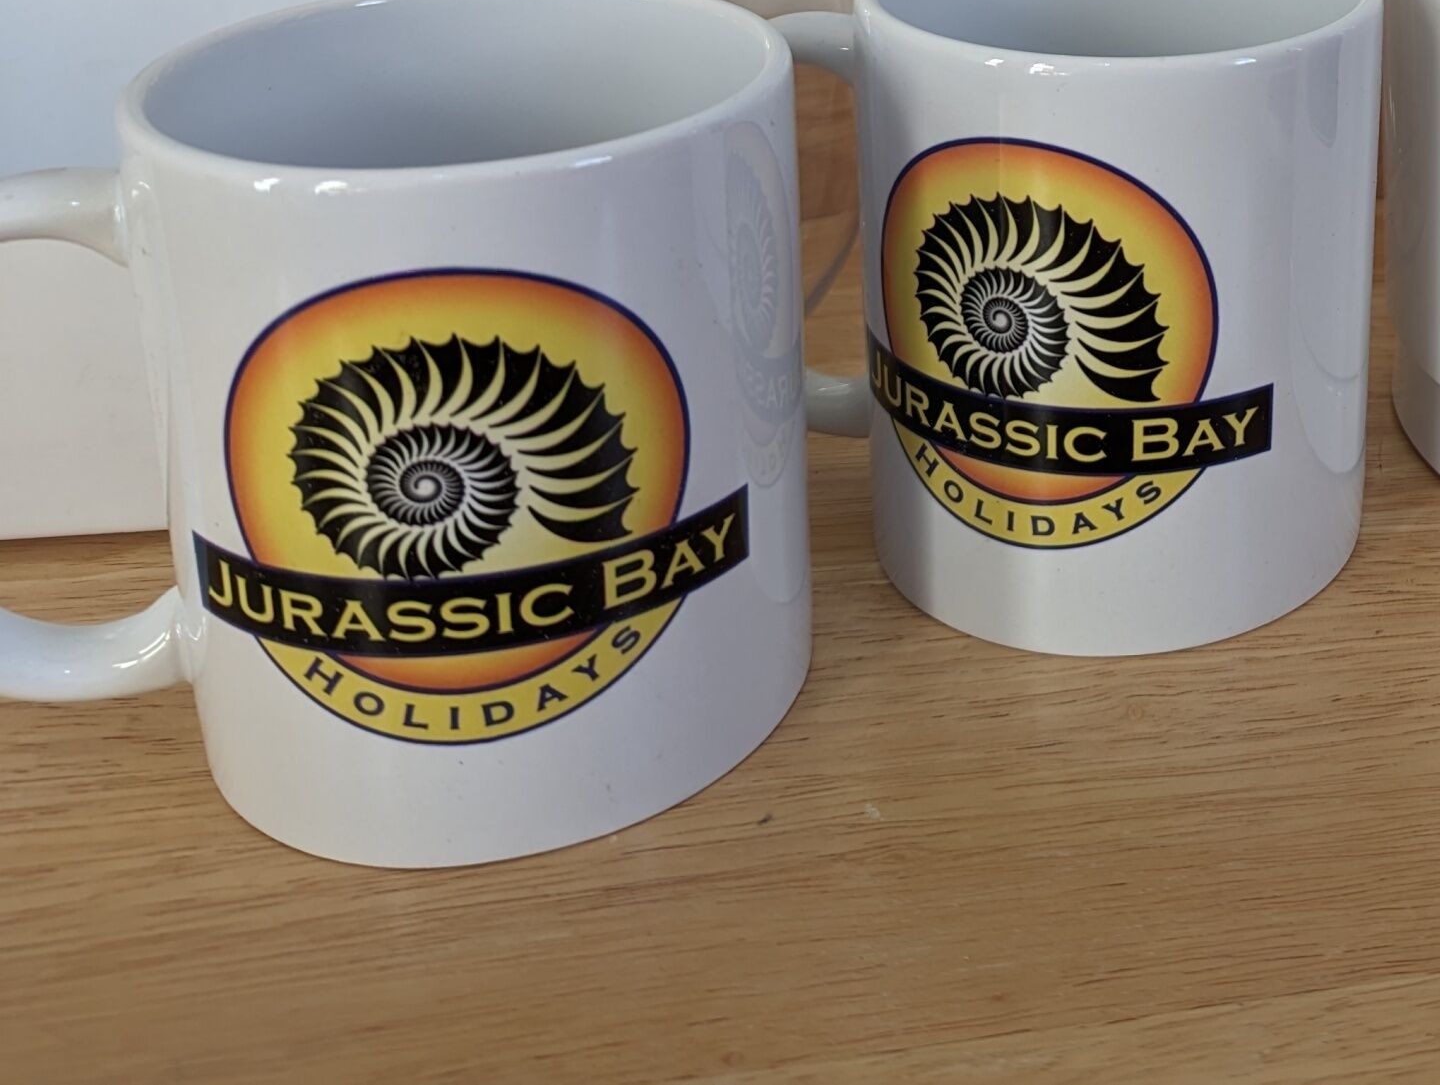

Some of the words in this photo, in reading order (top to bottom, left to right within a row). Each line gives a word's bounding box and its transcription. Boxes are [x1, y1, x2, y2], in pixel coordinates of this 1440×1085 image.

[871, 360, 1107, 463] JURASSIC
[1131, 405, 1260, 462] BAY
[914, 442, 1163, 537] HOLIDAYS
[207, 558, 575, 644] JURASSIC
[600, 512, 737, 610] BAY
[302, 624, 642, 731] HOLIDAYS
